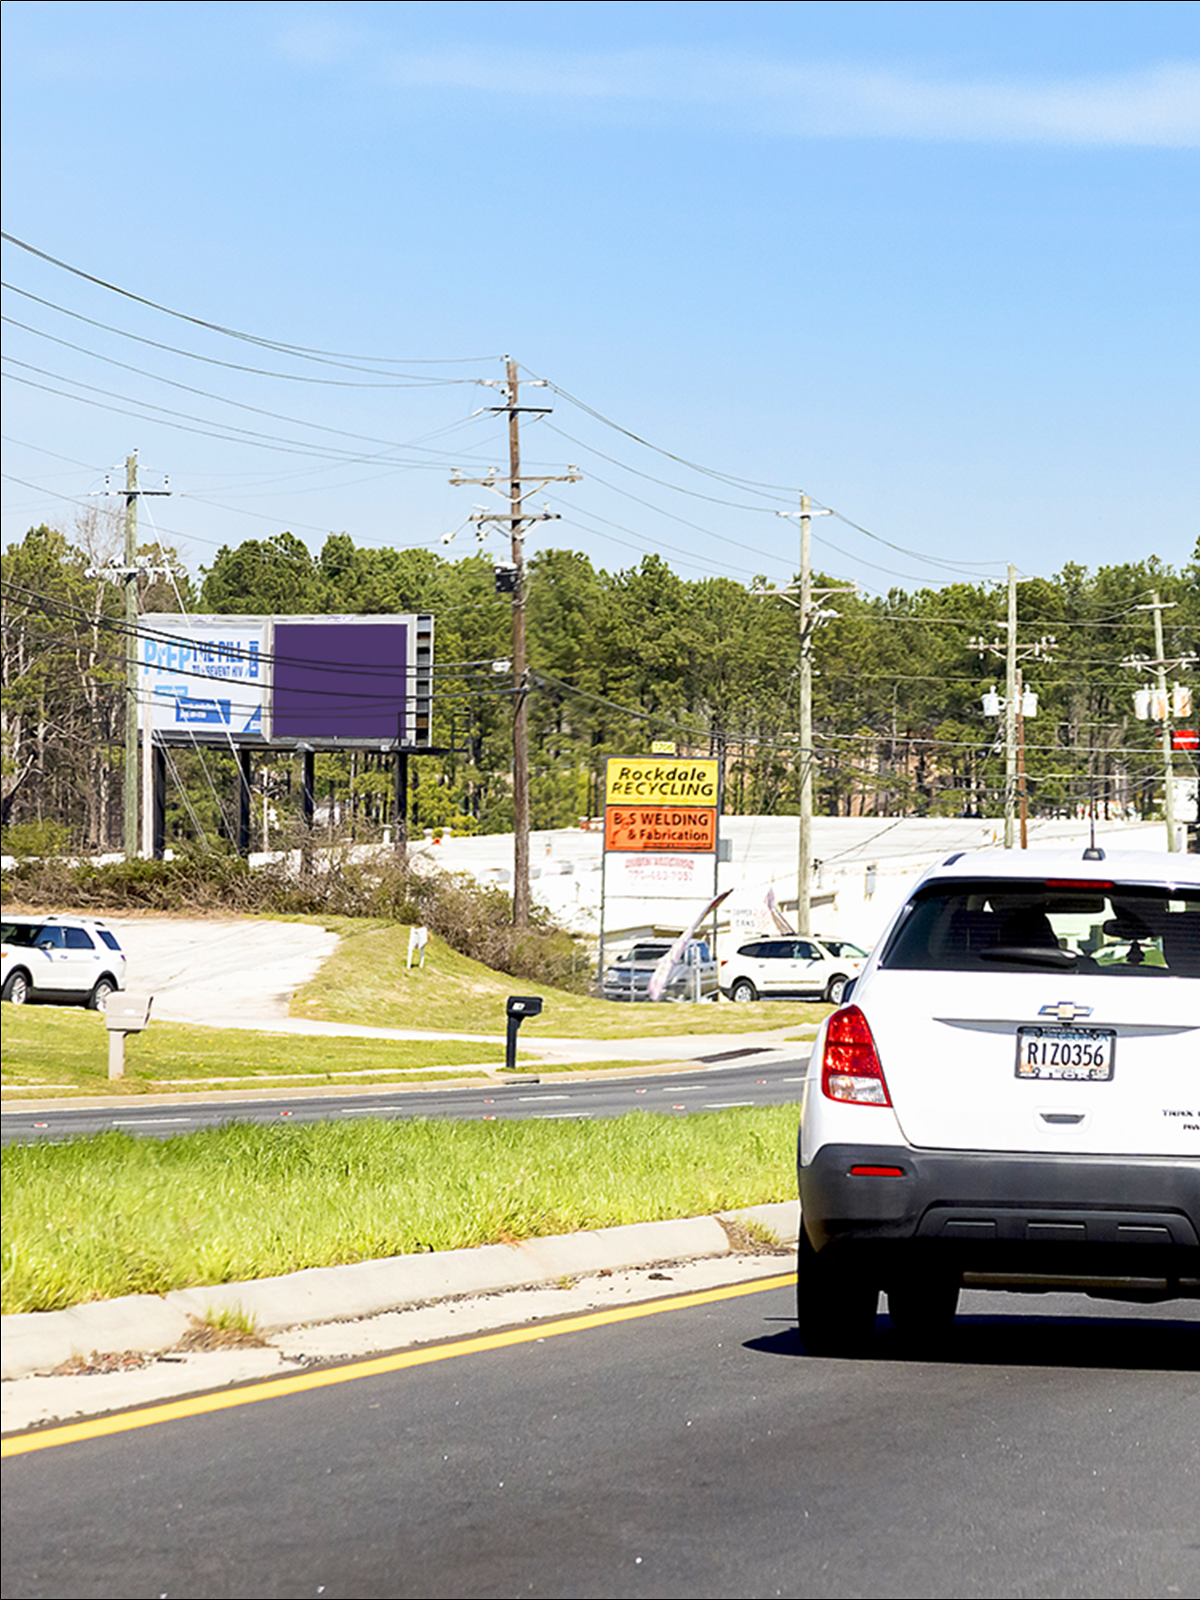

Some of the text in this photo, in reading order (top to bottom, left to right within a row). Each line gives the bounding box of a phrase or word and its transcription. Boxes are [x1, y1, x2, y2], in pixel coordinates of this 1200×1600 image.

[618, 767, 706, 781] Rockdale
[611, 782, 714, 796] RECYCLING
[640, 813, 709, 826] WELDING
[639, 829, 709, 841] Fabrication
[1027, 1042, 1104, 1067] RIZ0356
